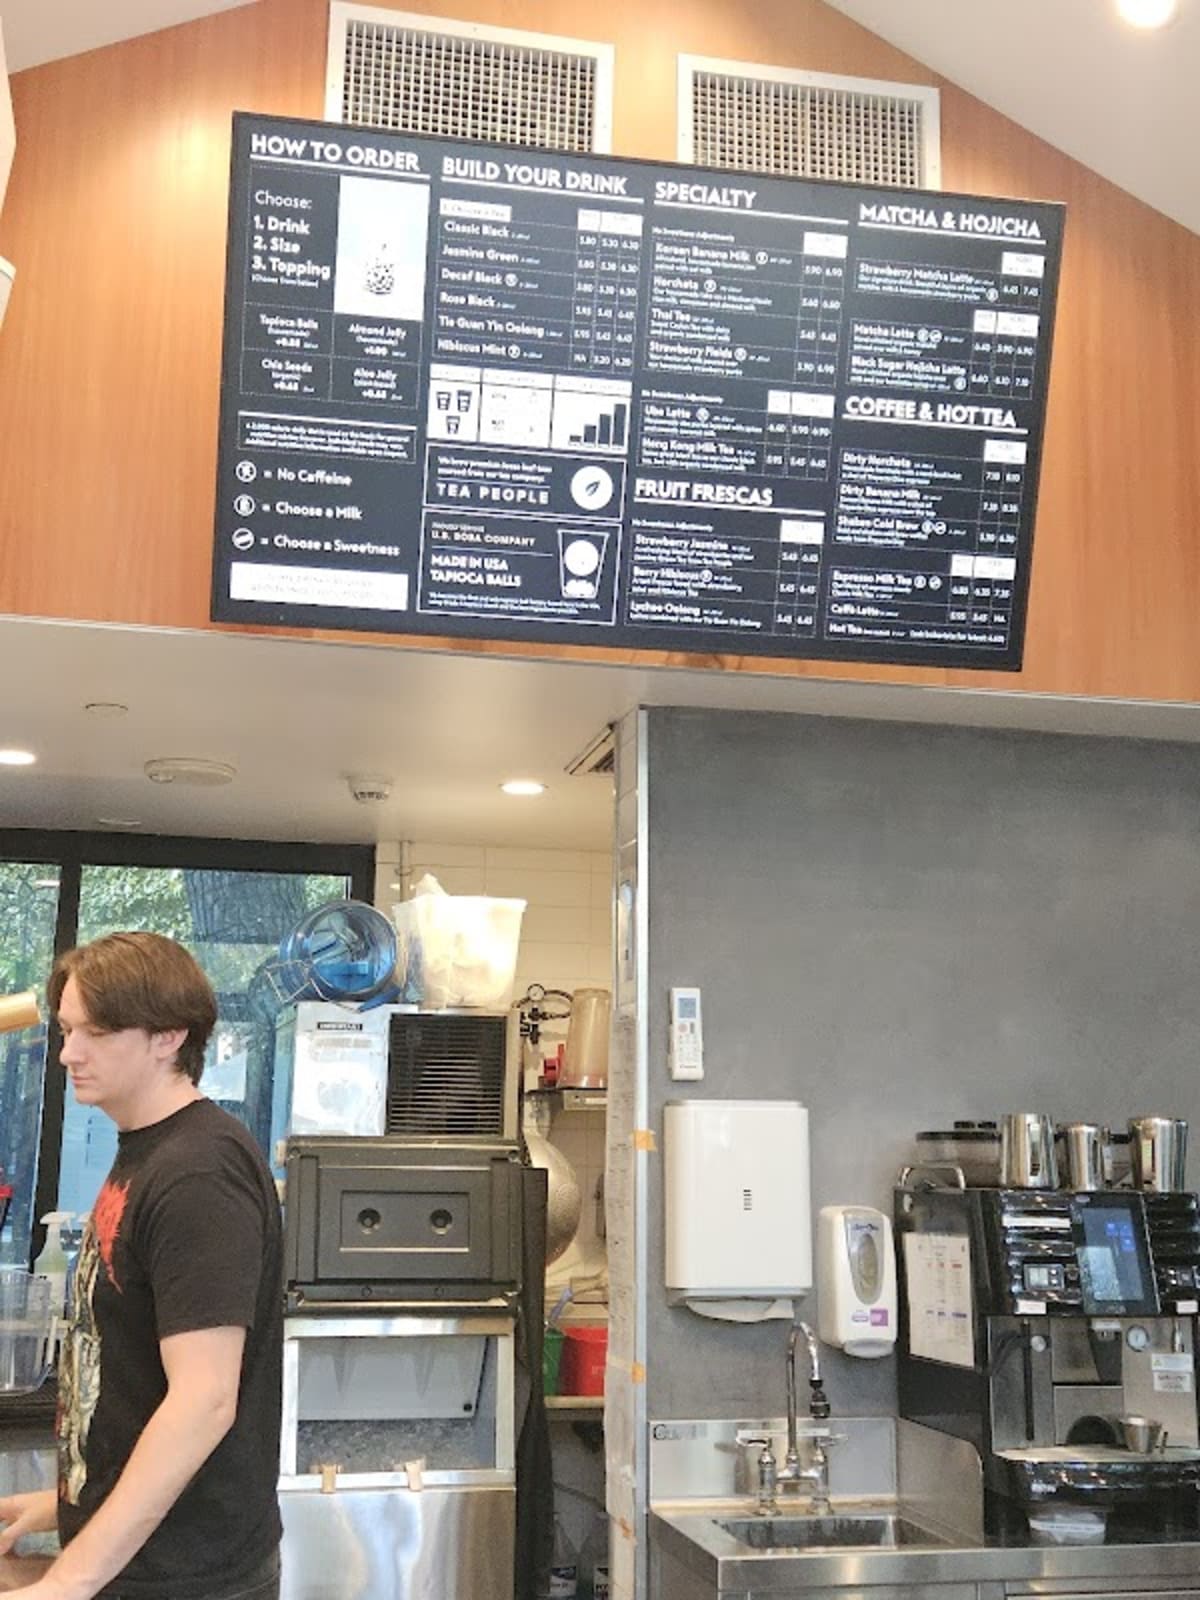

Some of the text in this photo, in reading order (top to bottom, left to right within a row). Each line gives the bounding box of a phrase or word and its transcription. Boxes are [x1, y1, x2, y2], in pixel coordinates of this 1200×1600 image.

[251, 134, 420, 171] HOW TO ORDER
[443, 156, 628, 195] BUILD YOUR DRINK
[254, 190, 312, 210] Choose:
[655, 181, 757, 209] SPECIALTY
[254, 215, 310, 235] 1. Drink
[444, 221, 510, 238] Classic Black
[859, 204, 1041, 238] MATCHA & HOJICHA
[253, 236, 301, 253] 2. Size
[442, 245, 519, 263] Jasmine Green
[692, 246, 728, 260] Banana
[729, 249, 750, 262] Milk
[252, 255, 331, 280] 3. Topping
[859, 262, 974, 283] Strawberry Matcha Latte
[441, 268, 502, 285] Decaf Black
[653, 275, 699, 291] Horchata
[440, 292, 496, 308] Rose Black
[260, 314, 319, 330] Tapioca Balls
[652, 308, 691, 323] Thai Tea
[349, 323, 407, 341] Almond Jelly
[438, 315, 545, 338] Tie Guan Yin Oolong
[853, 324, 915, 338] Matcha Latte
[437, 338, 506, 356] Hibiscus Mint
[649, 341, 732, 358] Strawberry Fields
[261, 358, 312, 373] Chia Seeds
[851, 355, 876, 367] Black
[878, 358, 904, 372] Sugar
[942, 363, 966, 376] Latte
[354, 368, 397, 382] Aloe Jelly
[645, 405, 691, 419] Ube Latte
[845, 396, 916, 419] COFFEE
[919, 402, 934, 421] &
[937, 404, 979, 425] HOT
[980, 406, 1017, 428] TEA
[643, 438, 734, 455] Hong Kong Milk Tea
[843, 452, 911, 468] Dirty Horchata
[277, 467, 352, 486] No Caffeine
[436, 483, 549, 504] TEA PEOPLE
[635, 477, 773, 506] FRUIT FRESCAS
[840, 484, 920, 501] Dirty Banana Milk
[275, 501, 363, 520] Choose a Milk
[873, 518, 895, 530] Cold
[895, 520, 919, 531] Brew
[274, 534, 400, 556] Choose a Sweetness
[484, 534, 535, 546] COMPANY
[635, 534, 728, 550] Strawberry Jasmine
[431, 554, 509, 570] MADE IN USA
[430, 570, 522, 587] TAPIOCA BALLS
[633, 566, 699, 581] Berry Hibiscus
[833, 571, 912, 586] Espresso Milk Tea
[630, 601, 701, 617] Lychee Oolong
[857, 606, 879, 616] Latte
[829, 624, 863, 636] Hot Tea
